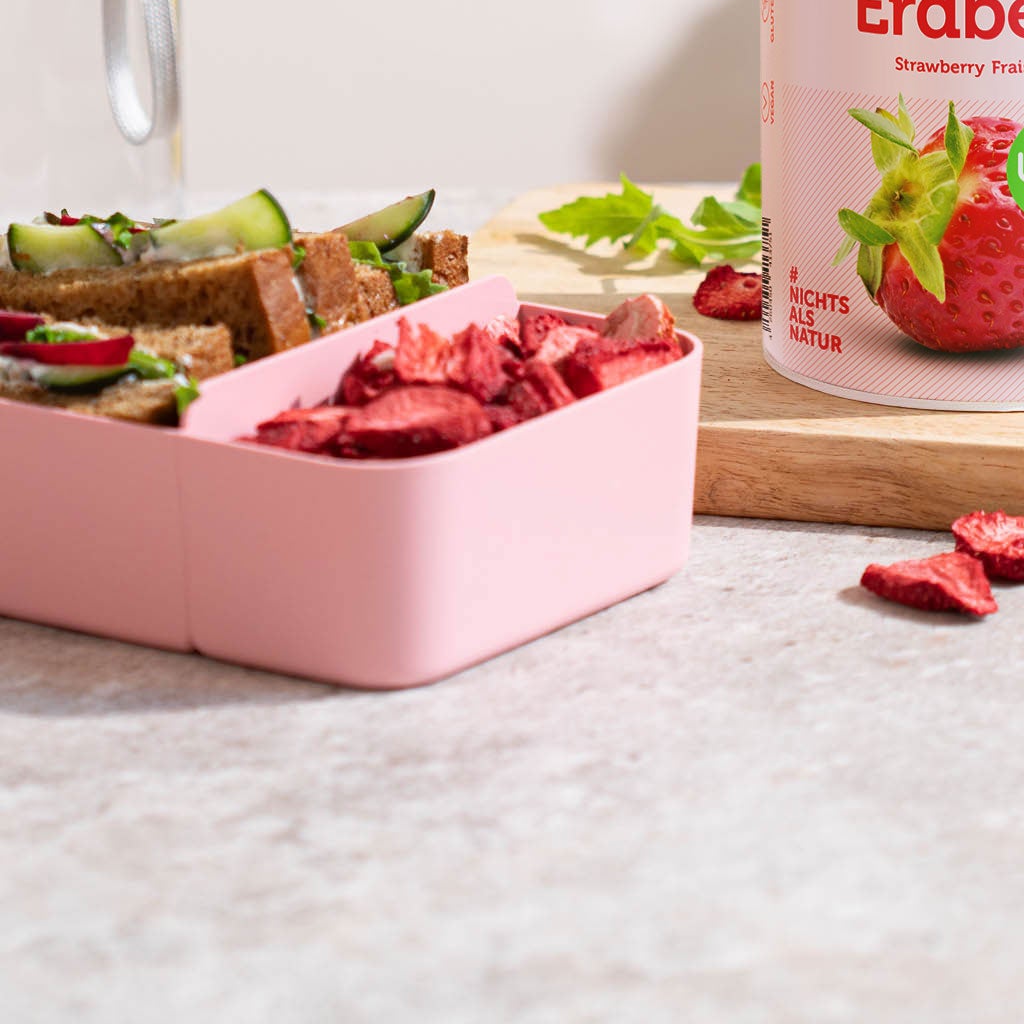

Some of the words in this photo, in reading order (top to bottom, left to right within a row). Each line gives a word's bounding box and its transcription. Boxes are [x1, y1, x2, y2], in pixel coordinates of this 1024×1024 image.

[894, 56, 985, 77] Strawberry
[789, 266, 799, 284] #
[789, 285, 850, 315] NICHTS
[789, 305, 815, 327] ALS
[789, 324, 842, 354] NATUR
